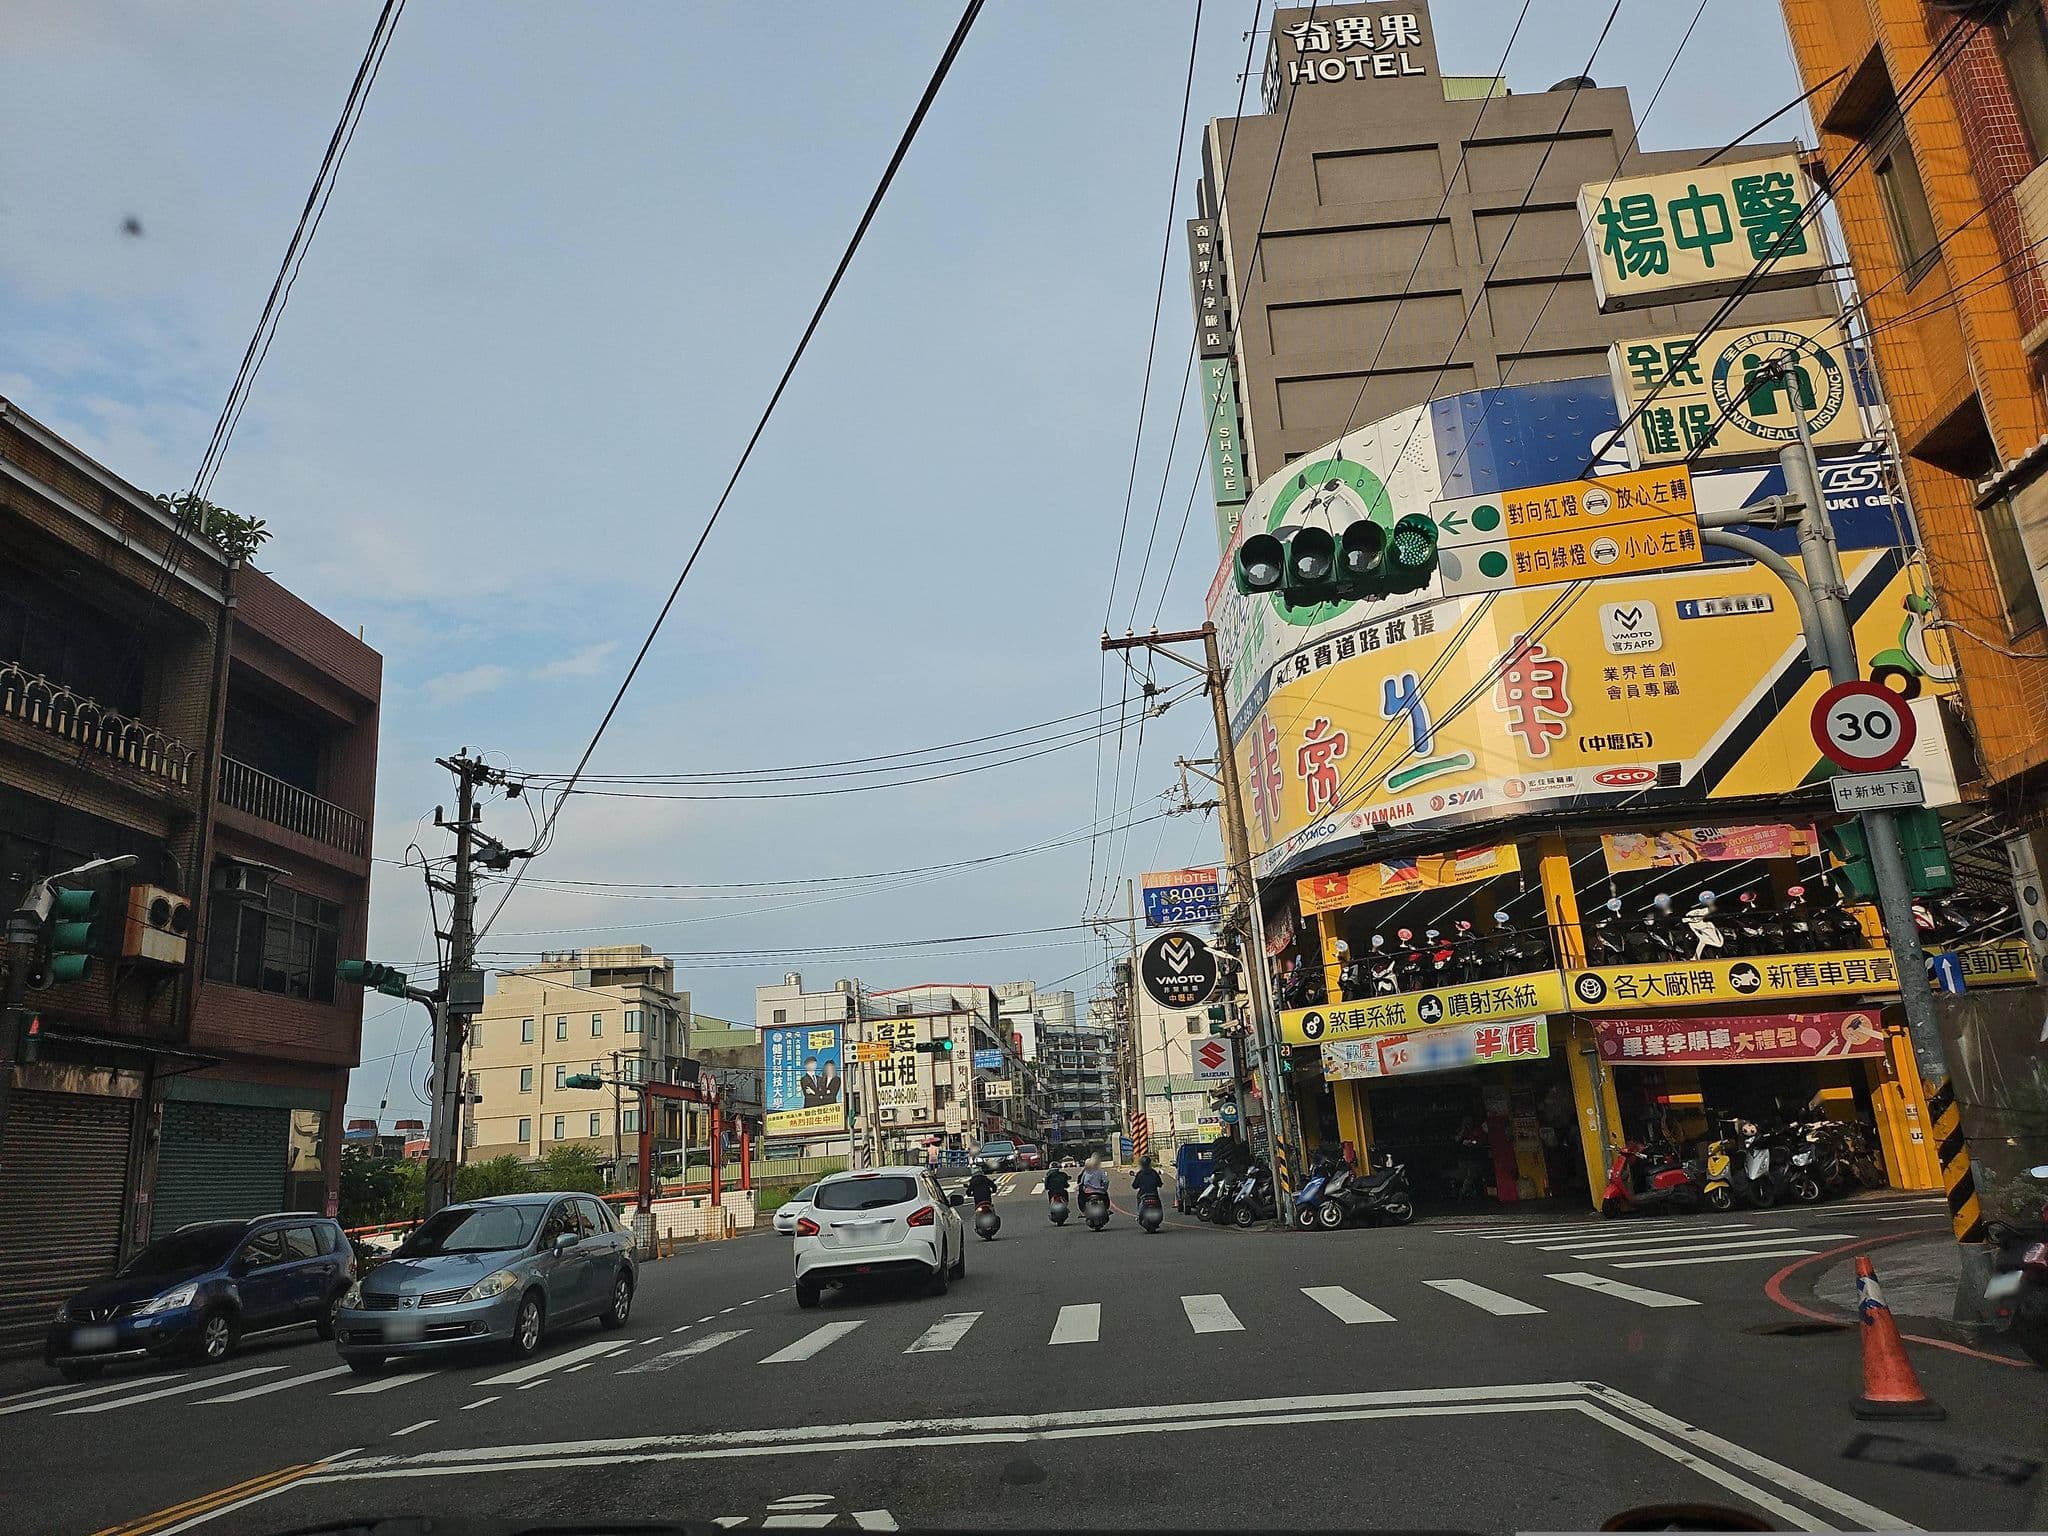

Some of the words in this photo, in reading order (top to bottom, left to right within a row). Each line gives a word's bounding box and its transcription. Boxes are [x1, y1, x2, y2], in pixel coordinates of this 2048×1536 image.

[1282, 14, 1421, 51] 奇異果
[1288, 52, 1425, 85] HOTEL
[1598, 172, 1806, 281] 楊中醫
[1193, 224, 1222, 346] 奇異果共享旅店
[1627, 339, 1704, 389] 全民
[1212, 367, 1230, 416] KIWI
[1712, 379, 1752, 432] NATINAL
[1756, 426, 1803, 441] HEALT
[1810, 365, 1843, 430] INSURANCE
[1640, 403, 1719, 454] 健保
[1218, 427, 1237, 492] SHARE
[1507, 495, 1580, 526] 對向紅燈
[1615, 478, 1689, 510] 放心左轉
[1825, 497, 1860, 511] UKI
[1515, 543, 1588, 574] 對向綠燈
[1625, 528, 1696, 560] 小心左轉
[1294, 610, 1435, 678] 免費道路救援
[1612, 631, 1652, 640] VMOTO
[1603, 662, 1676, 682] 業界首創
[1606, 680, 1680, 701] 會員專屬
[1578, 730, 1654, 754] (中壢店)
[1835, 710, 1893, 742] 30
[1602, 771, 1650, 783] PGO
[1839, 780, 1918, 801] 中新地下道
[1448, 788, 1484, 806] SYM
[1364, 802, 1415, 825] YAMAHA
[1175, 873, 1216, 885] HOTEL
[1169, 887, 1206, 904] 800
[1155, 974, 1205, 985] VMOTO
[1613, 970, 1716, 998] 各大廠牌
[1767, 957, 1896, 990] 新舊車買賣
[1448, 982, 1537, 1016] 噴射系統
[1329, 1001, 1407, 1033] 煞車系統
[1475, 1023, 1538, 1058] 半價
[1623, 1028, 1730, 1057] 畢業季購車
[1734, 1026, 1798, 1053] 大禮包
